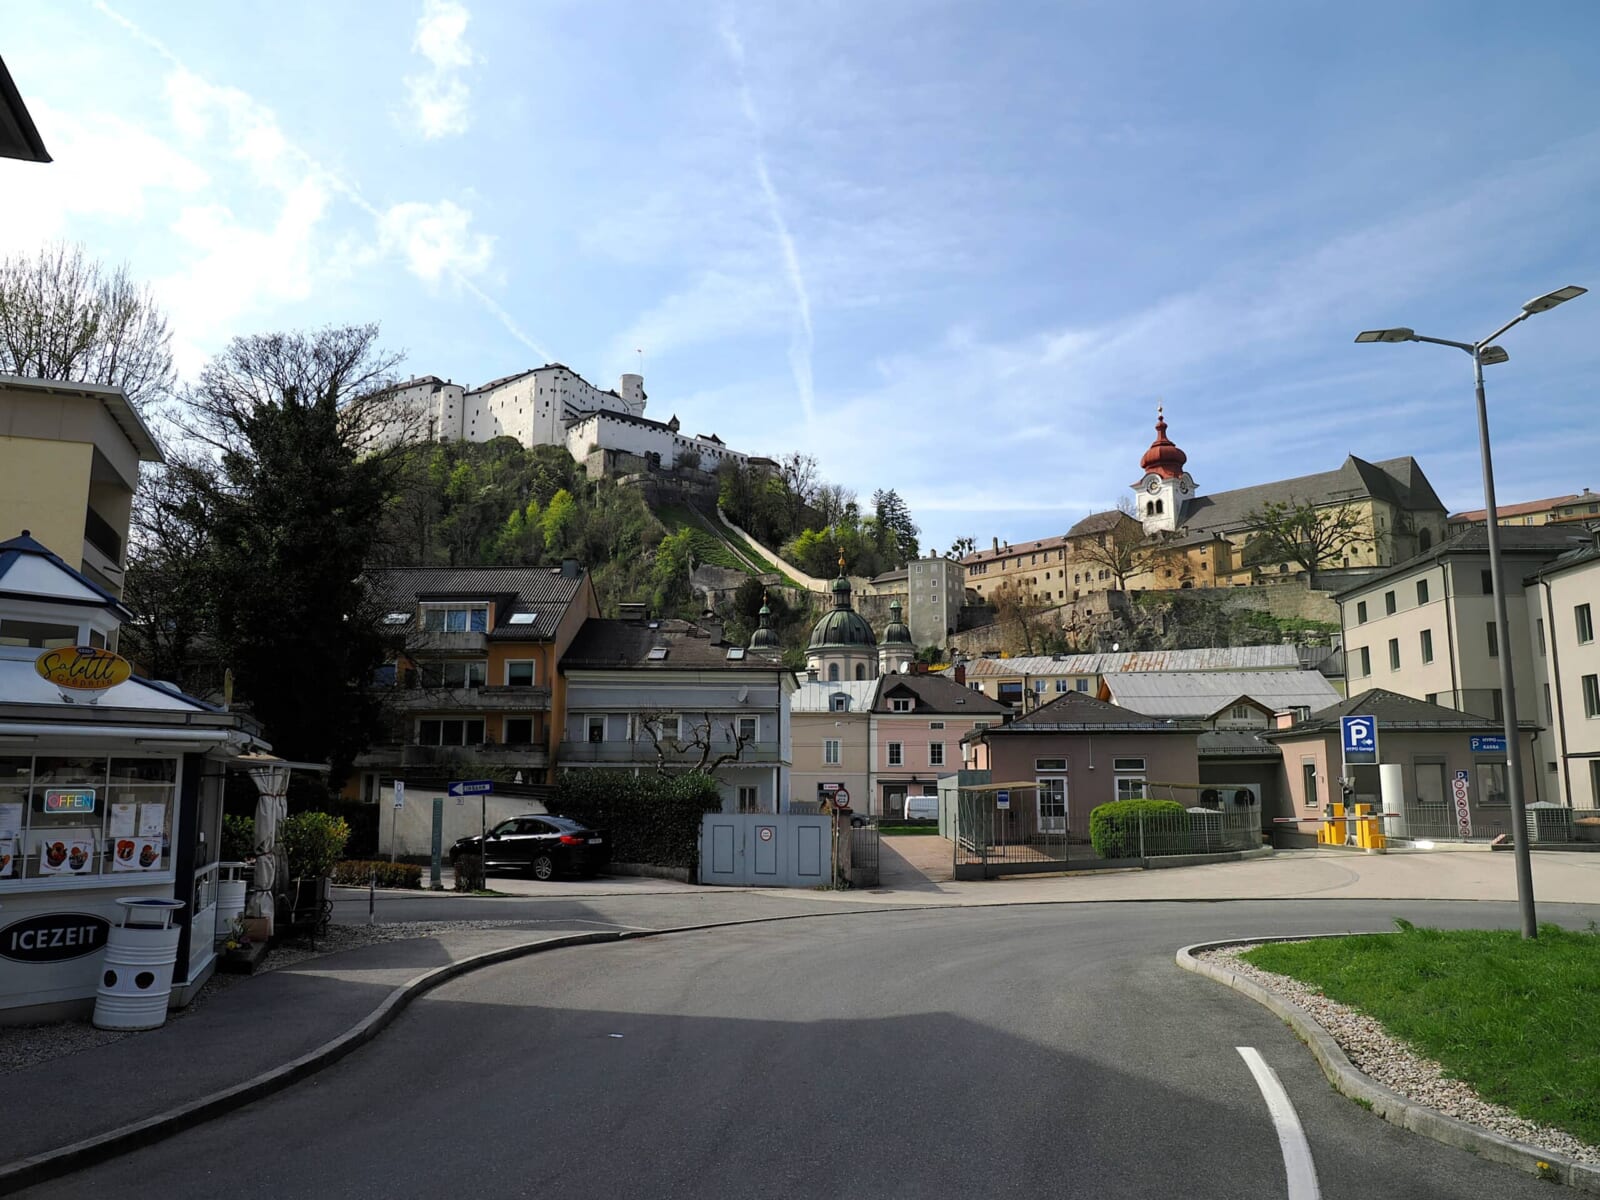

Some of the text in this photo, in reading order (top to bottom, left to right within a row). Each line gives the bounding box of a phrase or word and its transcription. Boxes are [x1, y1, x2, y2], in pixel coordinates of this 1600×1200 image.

[1351, 725, 1367, 746] P
[48, 794, 91, 807] OFFEN
[11, 925, 98, 951] ICEZEIT
